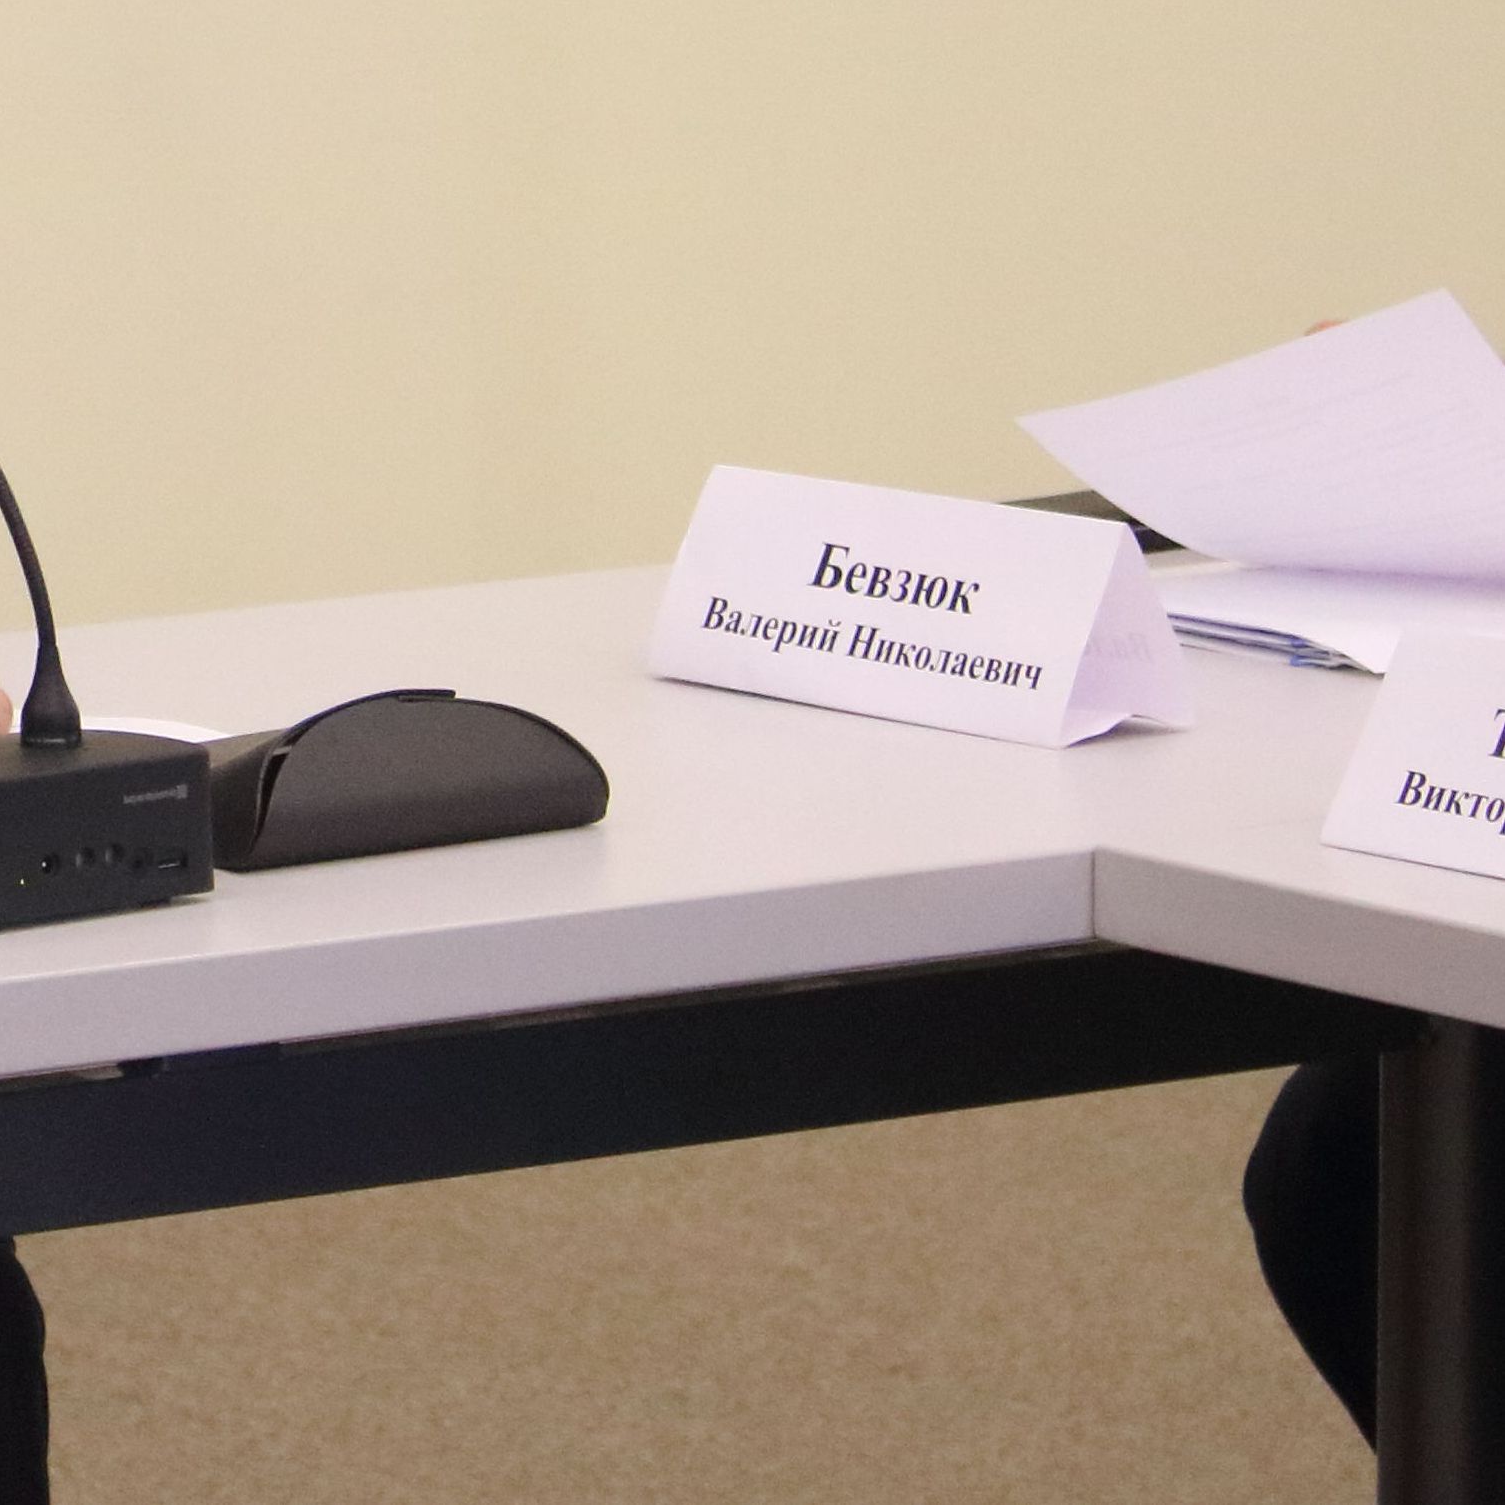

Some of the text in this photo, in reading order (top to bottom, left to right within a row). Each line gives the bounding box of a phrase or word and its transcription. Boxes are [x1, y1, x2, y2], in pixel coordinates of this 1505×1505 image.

[807, 540, 981, 615] Бевзюк
[700, 595, 842, 656] Валерий
[846, 620, 1045, 692] Николаевич
